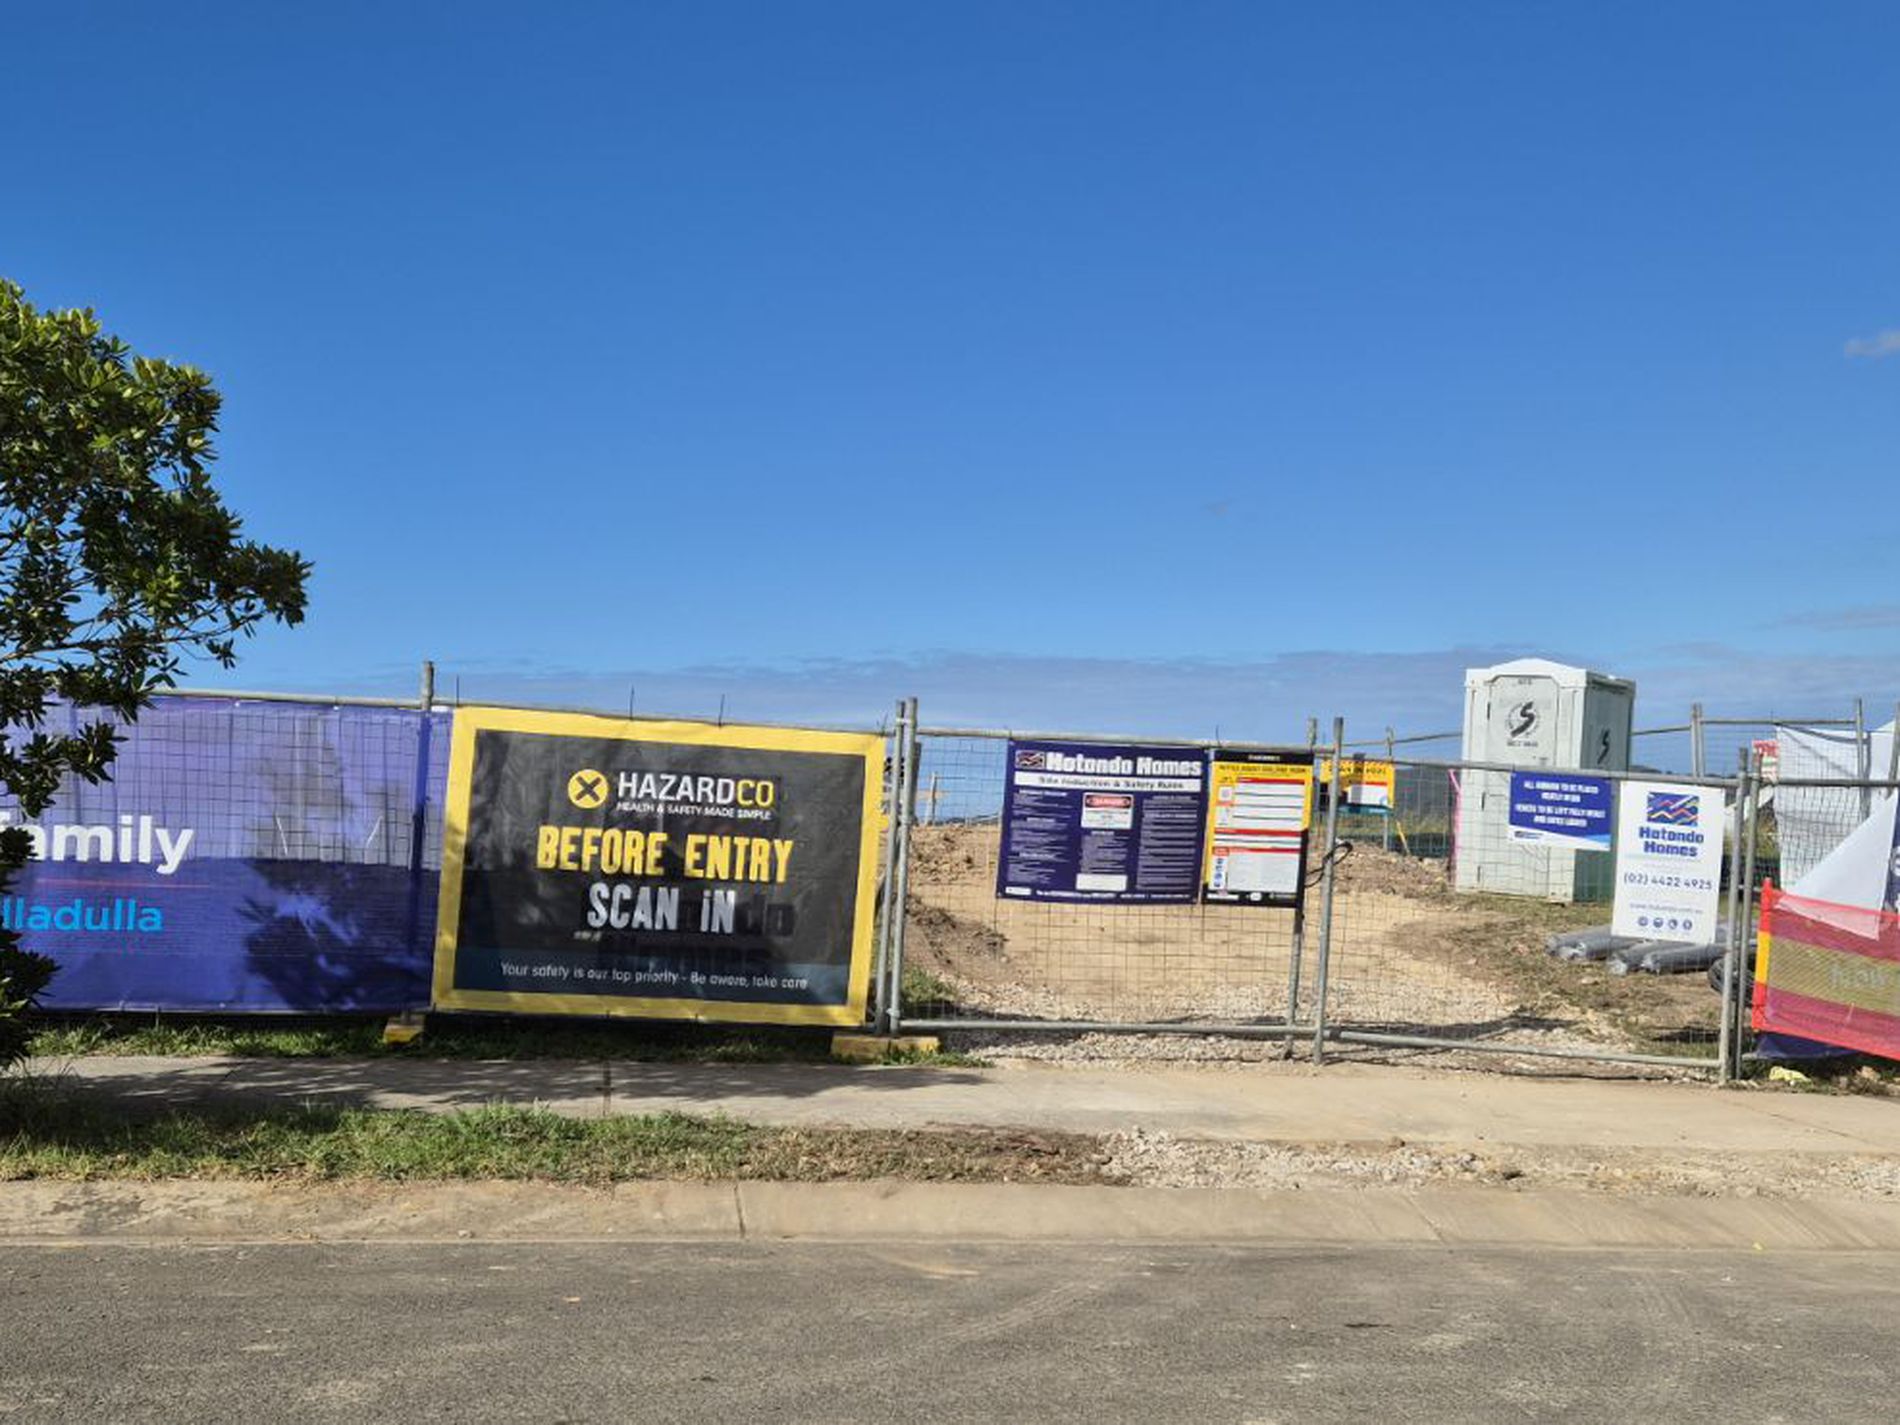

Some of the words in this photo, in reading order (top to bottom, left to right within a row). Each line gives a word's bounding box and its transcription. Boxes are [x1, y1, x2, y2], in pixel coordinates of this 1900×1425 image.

[1136, 757, 1202, 776] Homes
[618, 771, 775, 807] HAZARDCO
[616, 801, 655, 813] HEALTH
[667, 803, 702, 816] SAFETY
[704, 806, 735, 818] MADE
[737, 808, 773, 821] SIMPLE
[0, 812, 194, 875] amily
[1639, 826, 1705, 844] Hotondo
[536, 825, 668, 876] BEFORE
[683, 834, 794, 883] ENTRY
[1643, 841, 1698, 857] Homes
[1624, 872, 1649, 886] (02)
[1651, 876, 1681, 888] 4422
[587, 882, 679, 931] SCAN
[500, 962, 528, 976] Your
[532, 964, 570, 981] safety
[573, 967, 585, 979] is
[587, 969, 609, 980] our
[611, 968, 632, 984] top
[635, 966, 679, 985] priority
[690, 971, 706, 985] Be
[752, 975, 777, 988] take
[781, 977, 808, 990] care
